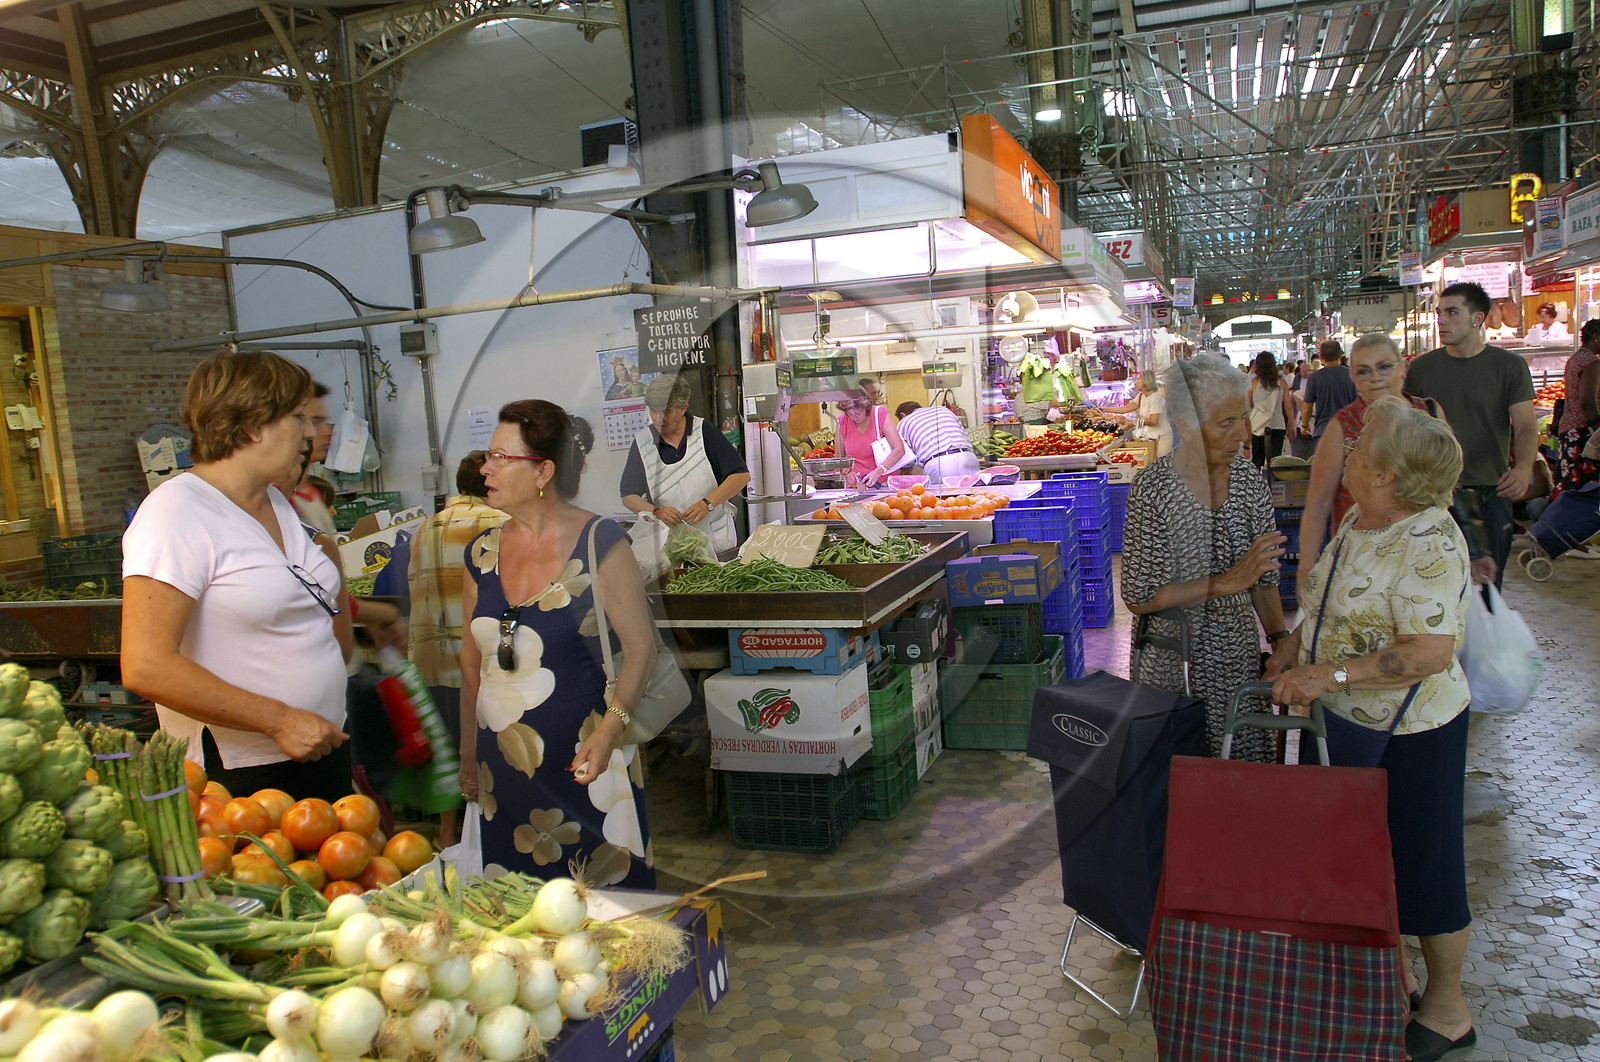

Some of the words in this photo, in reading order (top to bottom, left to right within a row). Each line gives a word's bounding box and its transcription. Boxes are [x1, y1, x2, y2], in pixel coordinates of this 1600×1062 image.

[1572, 214, 1593, 233] RAFA
[641, 312, 655, 325] SE
[657, 306, 699, 323] PROHIBE
[648, 322, 682, 337] TOCAR
[683, 322, 696, 334] EL
[647, 336, 690, 352] GENERO
[691, 334, 711, 349] POR
[656, 350, 706, 367] HIGIENE
[1060, 716, 1100, 744] CLASSIC
[742, 739, 780, 753] VERDURAS
[782, 740, 788, 753] Y
[788, 741, 836, 754] HORTALIZAS
